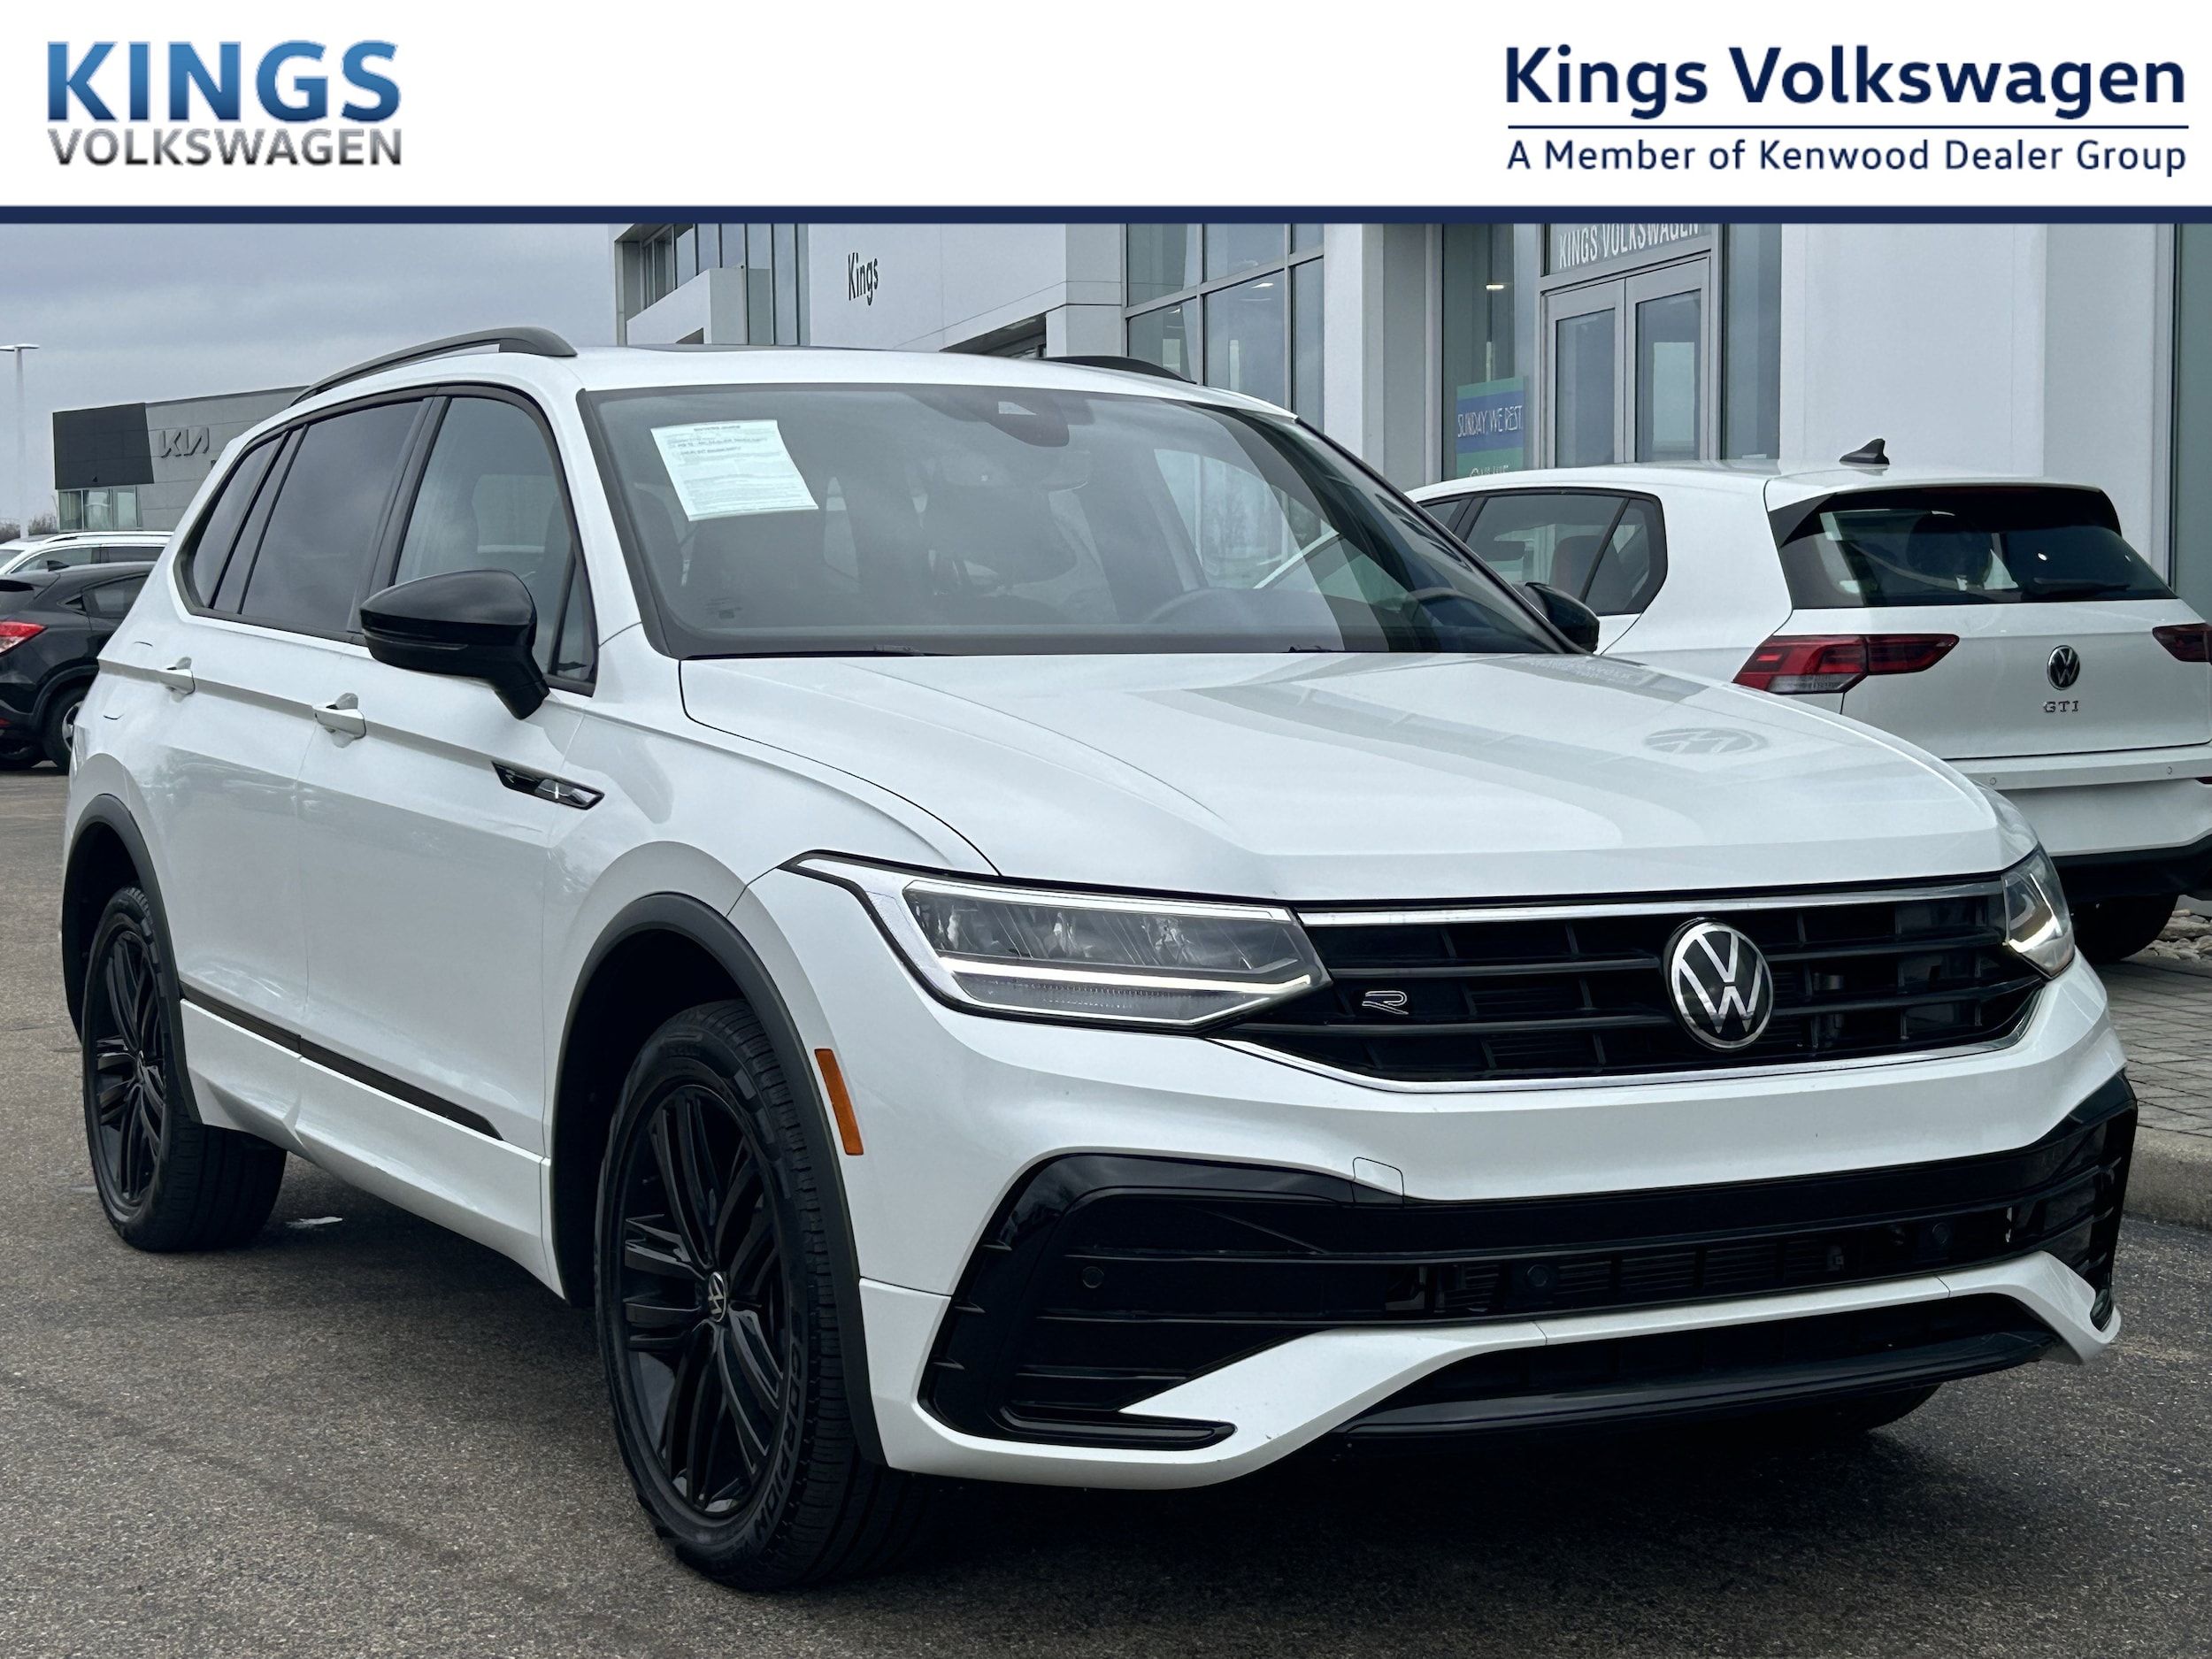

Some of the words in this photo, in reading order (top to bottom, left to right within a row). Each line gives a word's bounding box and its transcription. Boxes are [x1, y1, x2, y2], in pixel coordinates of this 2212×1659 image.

[1559, 225, 1598, 269] KINGS
[1602, 223, 1699, 258] VOLKSWA
[848, 252, 879, 306] Kings
[2043, 700, 2079, 713] GTI
